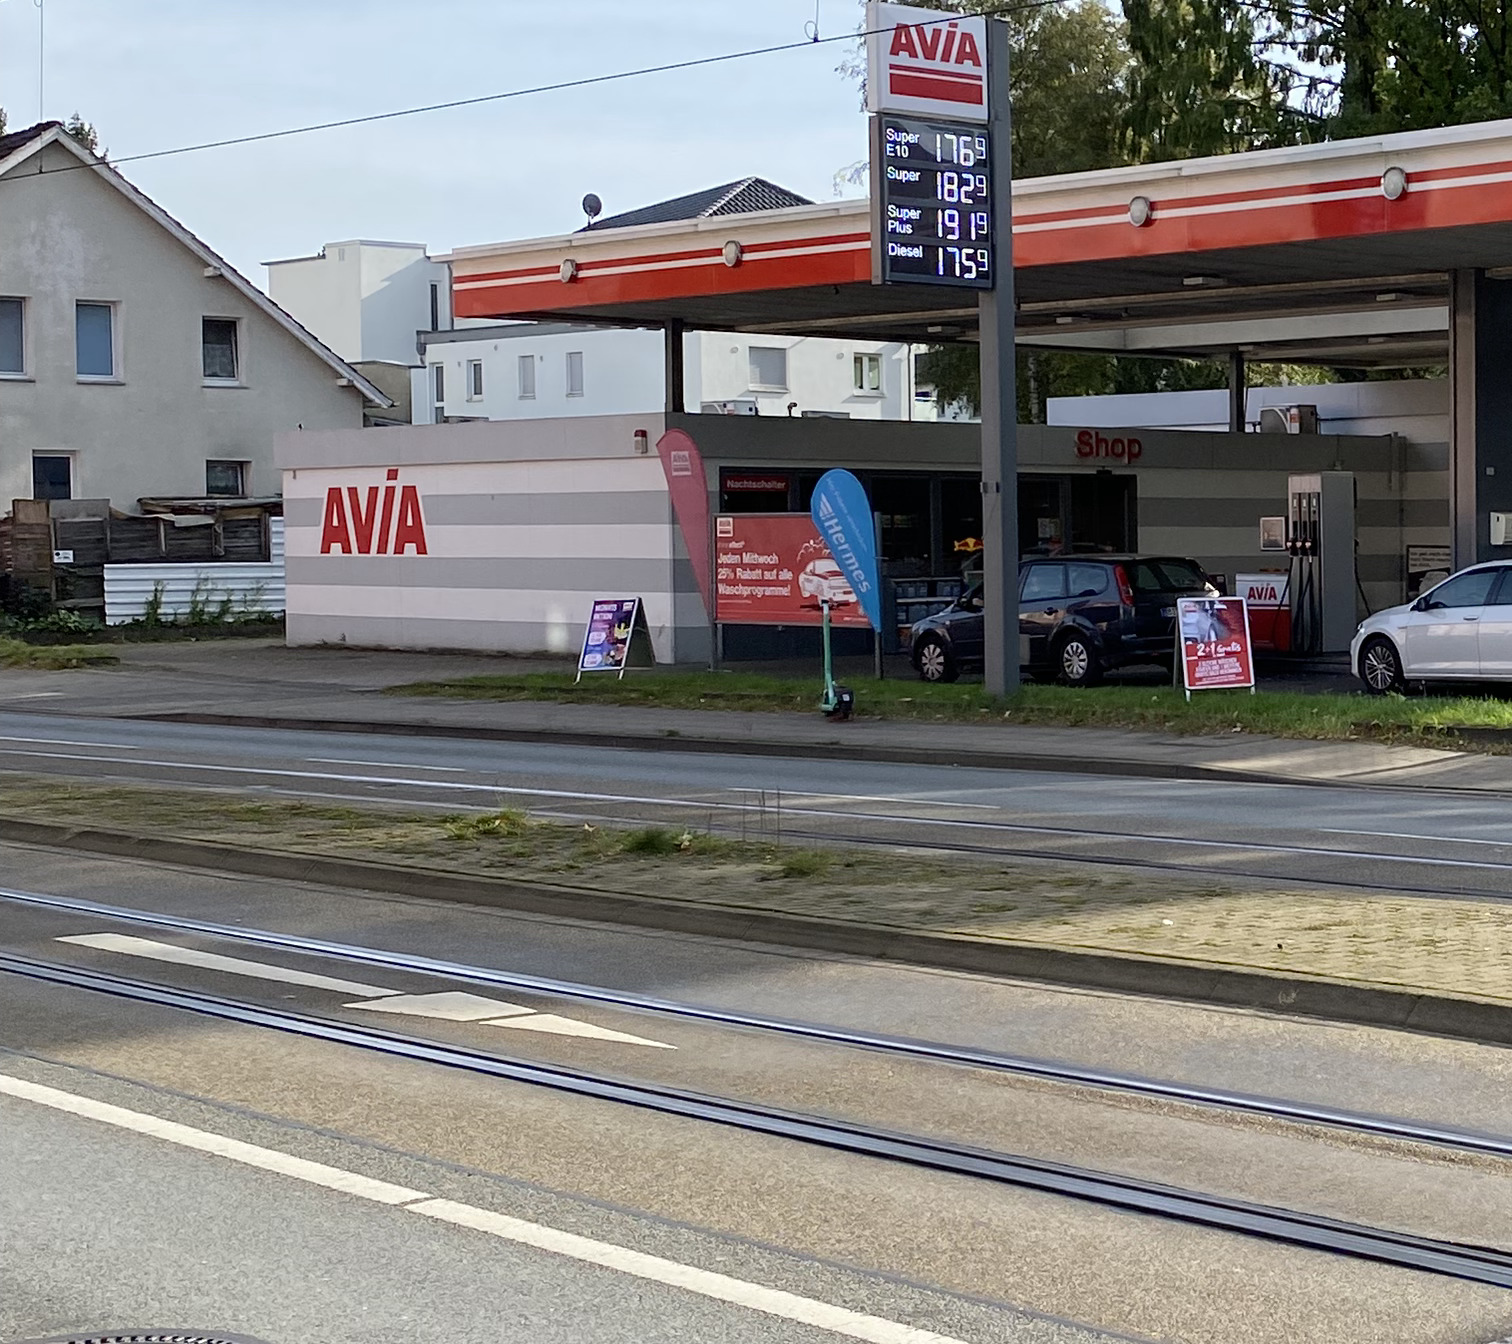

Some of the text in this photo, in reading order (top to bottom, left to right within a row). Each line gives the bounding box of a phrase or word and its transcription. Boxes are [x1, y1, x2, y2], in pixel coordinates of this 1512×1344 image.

[889, 22, 982, 67] AVIA
[886, 128, 920, 145] Super
[886, 142, 909, 158] E10
[887, 166, 921, 183] Super
[888, 204, 922, 221] Super
[888, 219, 913, 235] Plus
[888, 242, 923, 258] Diesel
[1076, 430, 1142, 464] Shop
[726, 479, 786, 489] Nachtschalter
[320, 468, 428, 555] AVIA
[717, 553, 779, 564] Jeden Mittwoch
[824, 518, 872, 593] Hermes
[717, 568, 794, 580] 25% Rabatt auf alle
[717, 584, 791, 598] Waschprogramme!
[1247, 583, 1277, 600] AVIA
